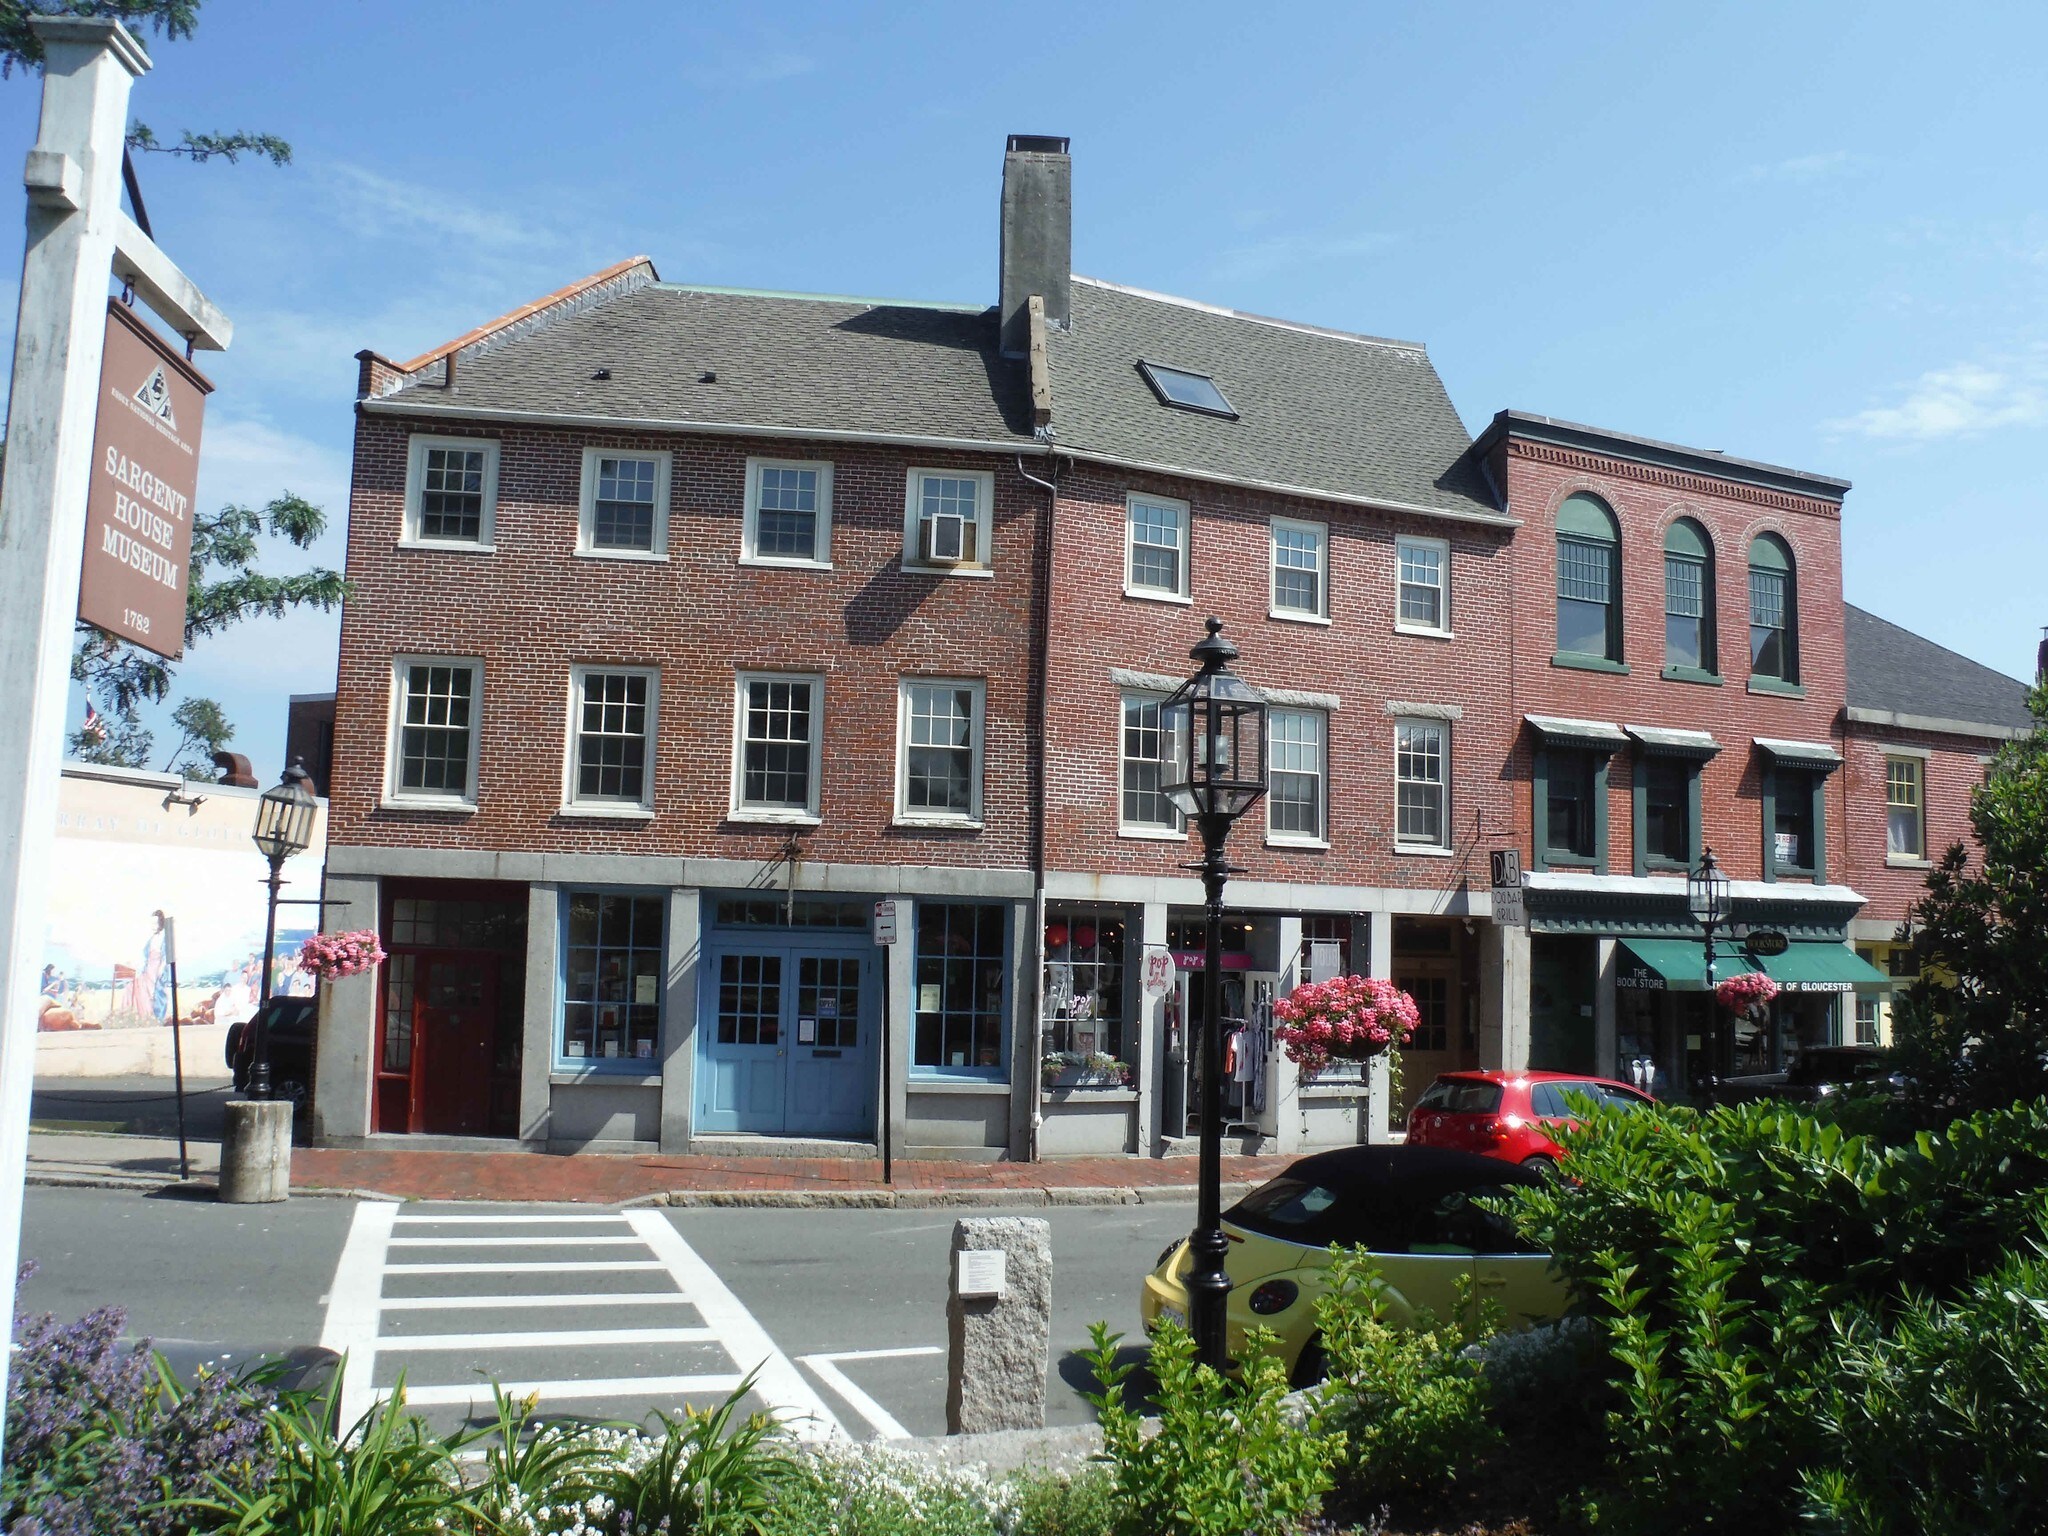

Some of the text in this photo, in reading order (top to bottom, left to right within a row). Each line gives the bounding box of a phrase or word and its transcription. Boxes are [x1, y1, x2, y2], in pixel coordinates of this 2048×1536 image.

[105, 446, 187, 521] SARGENT
[113, 491, 173, 550] HOUSE
[102, 523, 178, 590] MUSEUM
[123, 608, 150, 634] 1782
[1497, 908, 1519, 921] GRILL
[1149, 955, 1169, 976] pop
[1183, 955, 1198, 966] pop
[1633, 968, 1648, 978] THE
[1616, 977, 1664, 989] BOOK STORE
[1786, 982, 1797, 991] OF
[1801, 983, 1853, 991] GLOUCESTER
